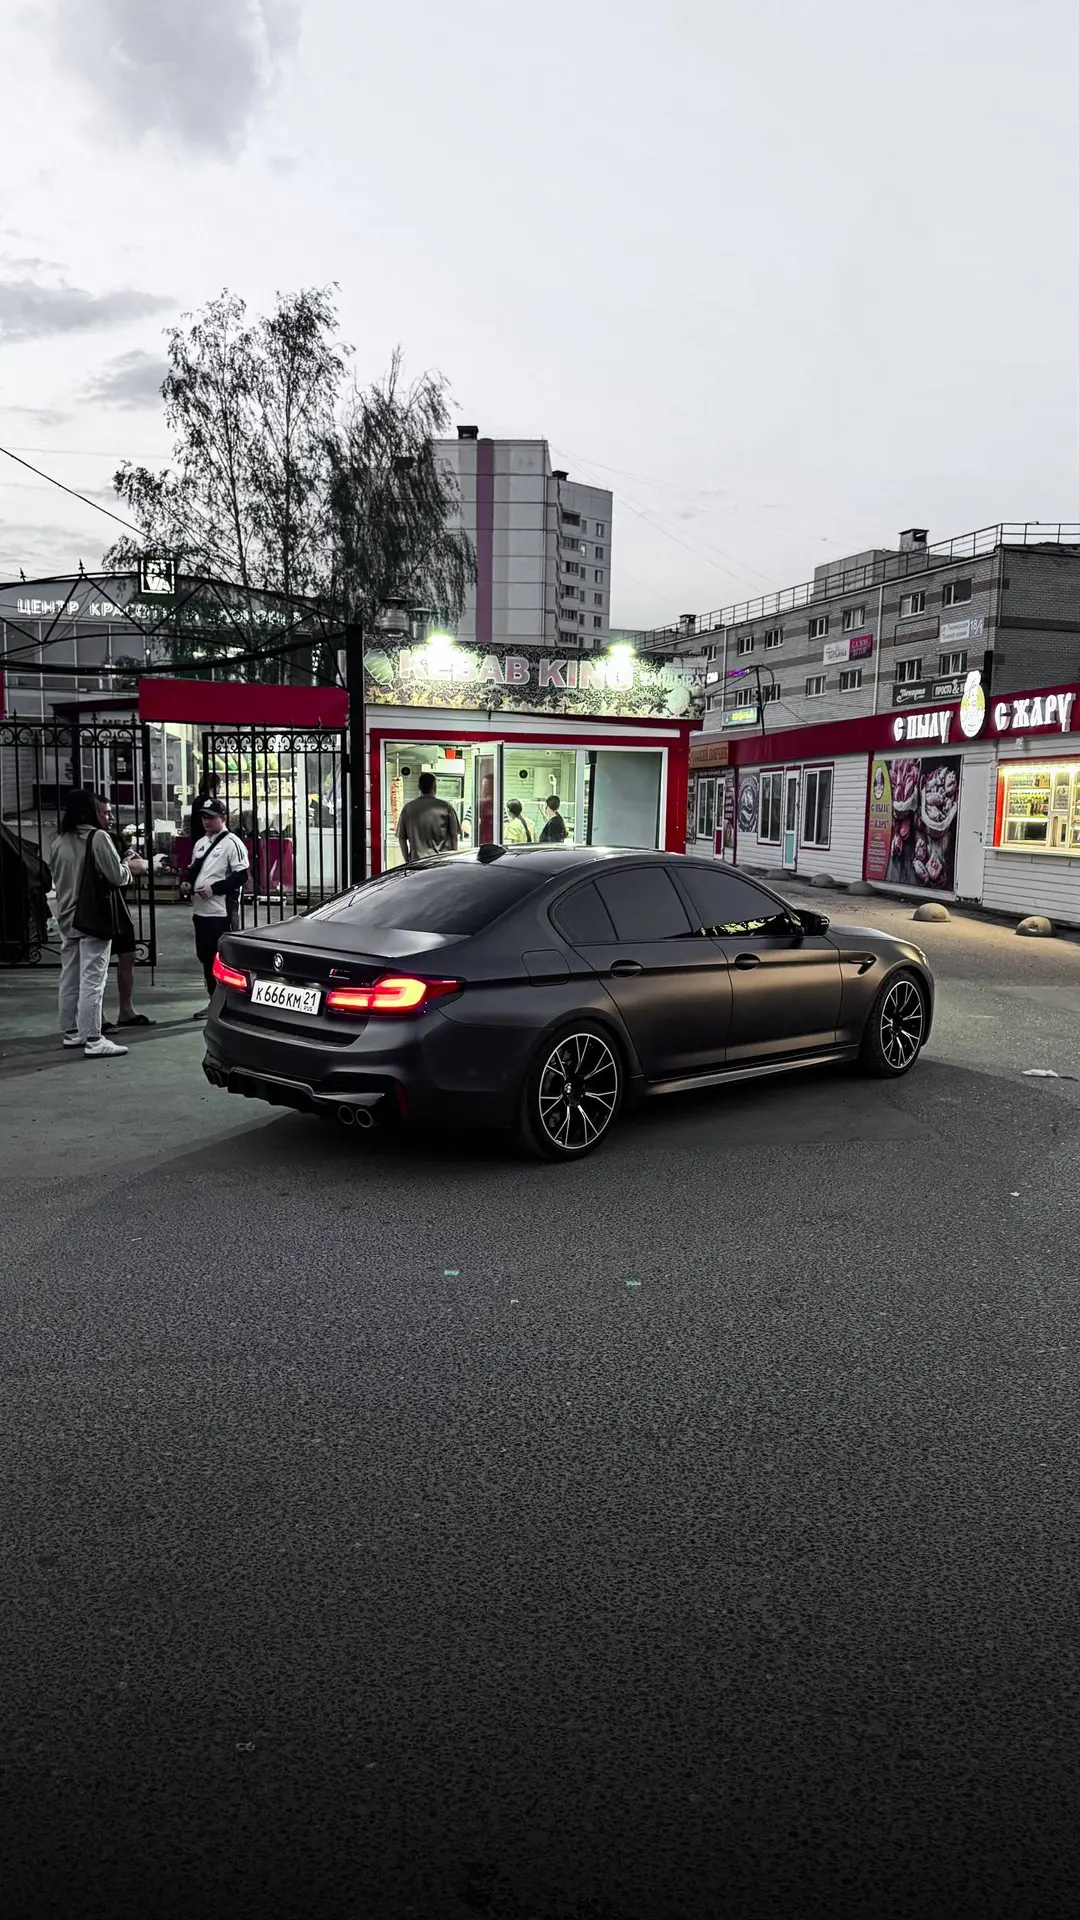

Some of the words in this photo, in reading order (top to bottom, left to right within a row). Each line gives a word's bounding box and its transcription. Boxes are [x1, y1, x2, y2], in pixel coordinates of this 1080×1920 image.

[17, 598, 80, 615] ЦЕНТР
[400, 649, 531, 686] KEBAB
[538, 658, 634, 691] KING
[893, 717, 904, 742] С
[906, 710, 951, 743] ПЫЛУ
[994, 702, 1008, 731] С
[1011, 692, 1073, 732] ЖАРУ
[303, 991, 317, 1006] 21
